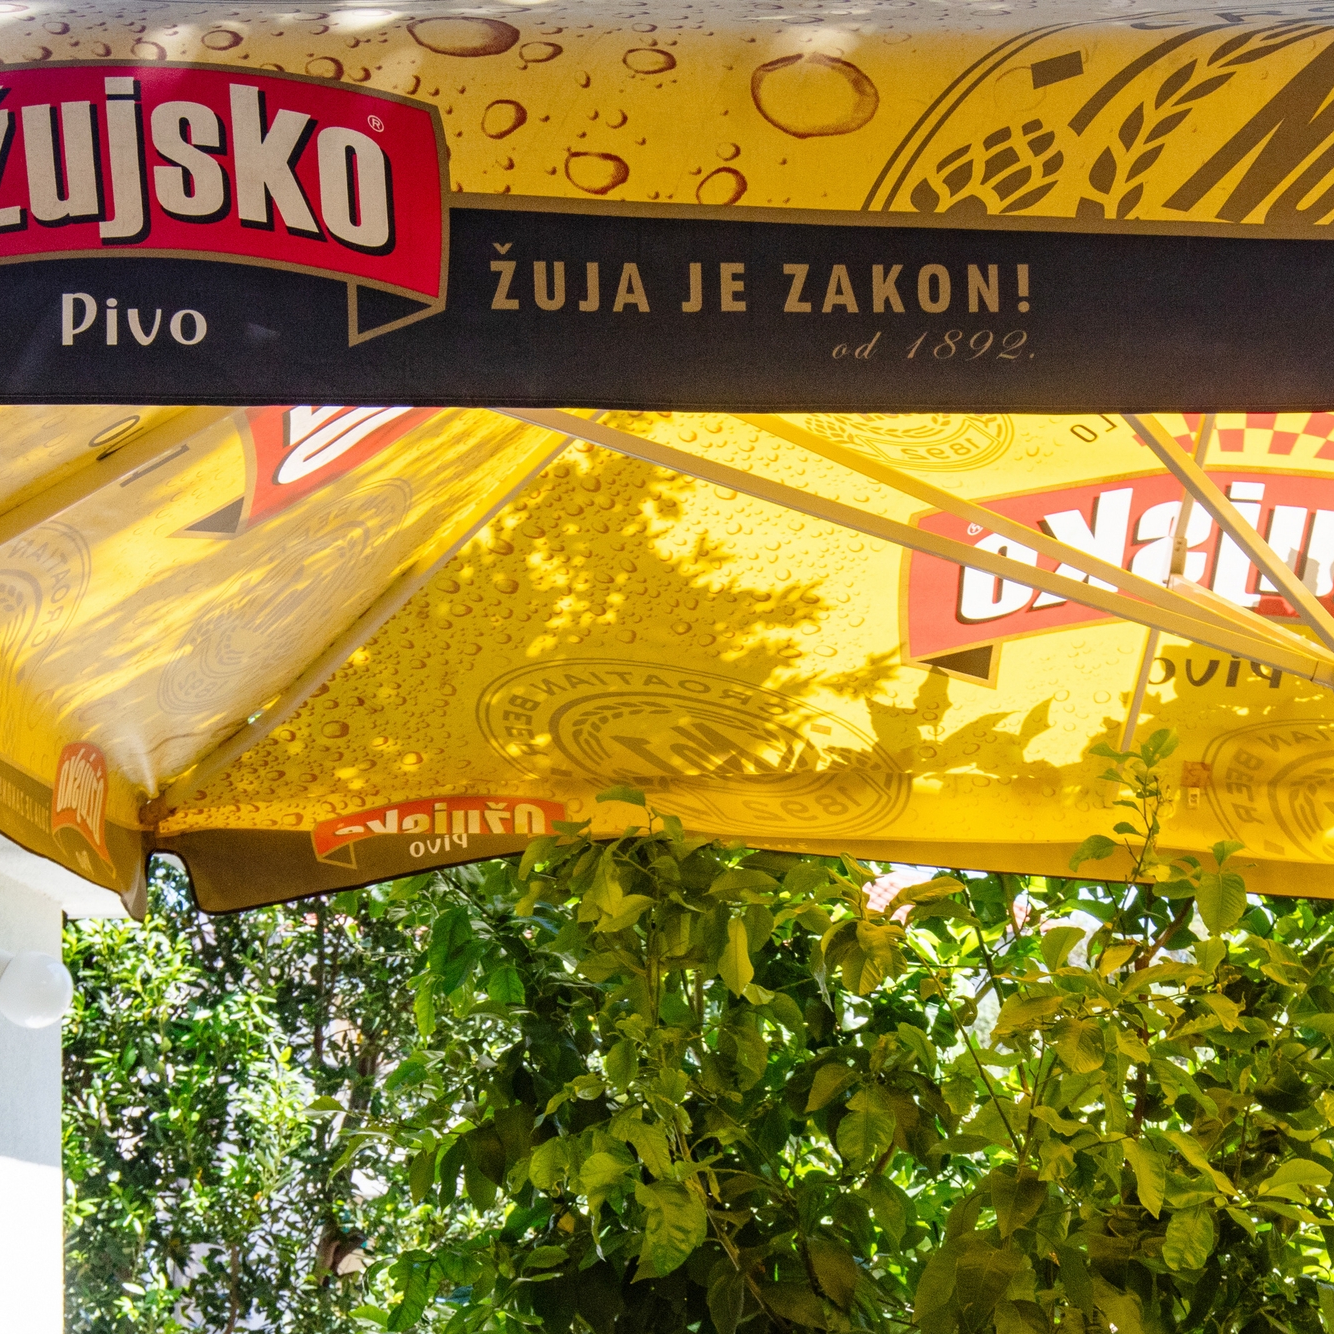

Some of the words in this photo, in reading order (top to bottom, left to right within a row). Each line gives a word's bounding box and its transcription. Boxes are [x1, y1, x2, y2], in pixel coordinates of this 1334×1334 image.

[488, 241, 652, 313] ŽUJA
[680, 261, 748, 313] JE
[782, 263, 1032, 314] ZAKON!
[60, 292, 208, 346] Pivo
[831, 331, 881, 360] od
